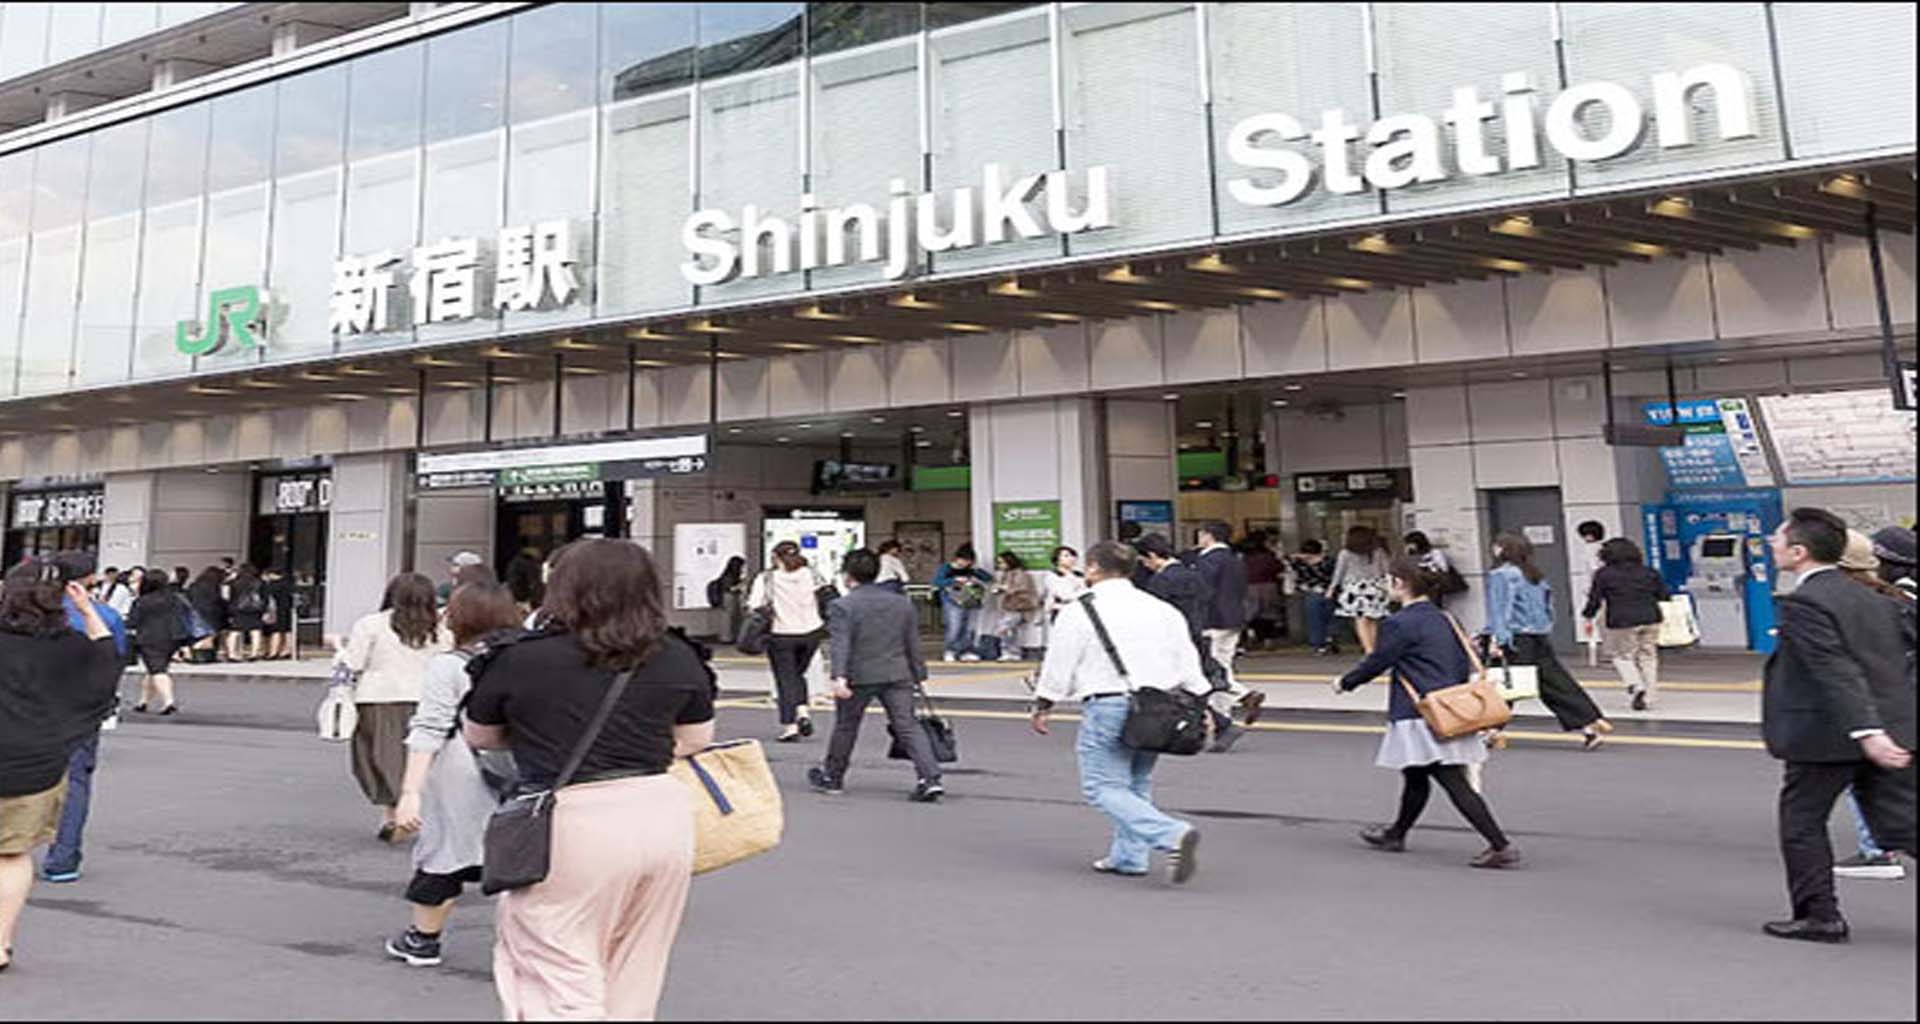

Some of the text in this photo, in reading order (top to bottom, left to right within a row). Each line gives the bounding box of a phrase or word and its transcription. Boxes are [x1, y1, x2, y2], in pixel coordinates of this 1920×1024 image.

[175, 62, 1756, 355] JR 新宿駅 Shinjuku Station
